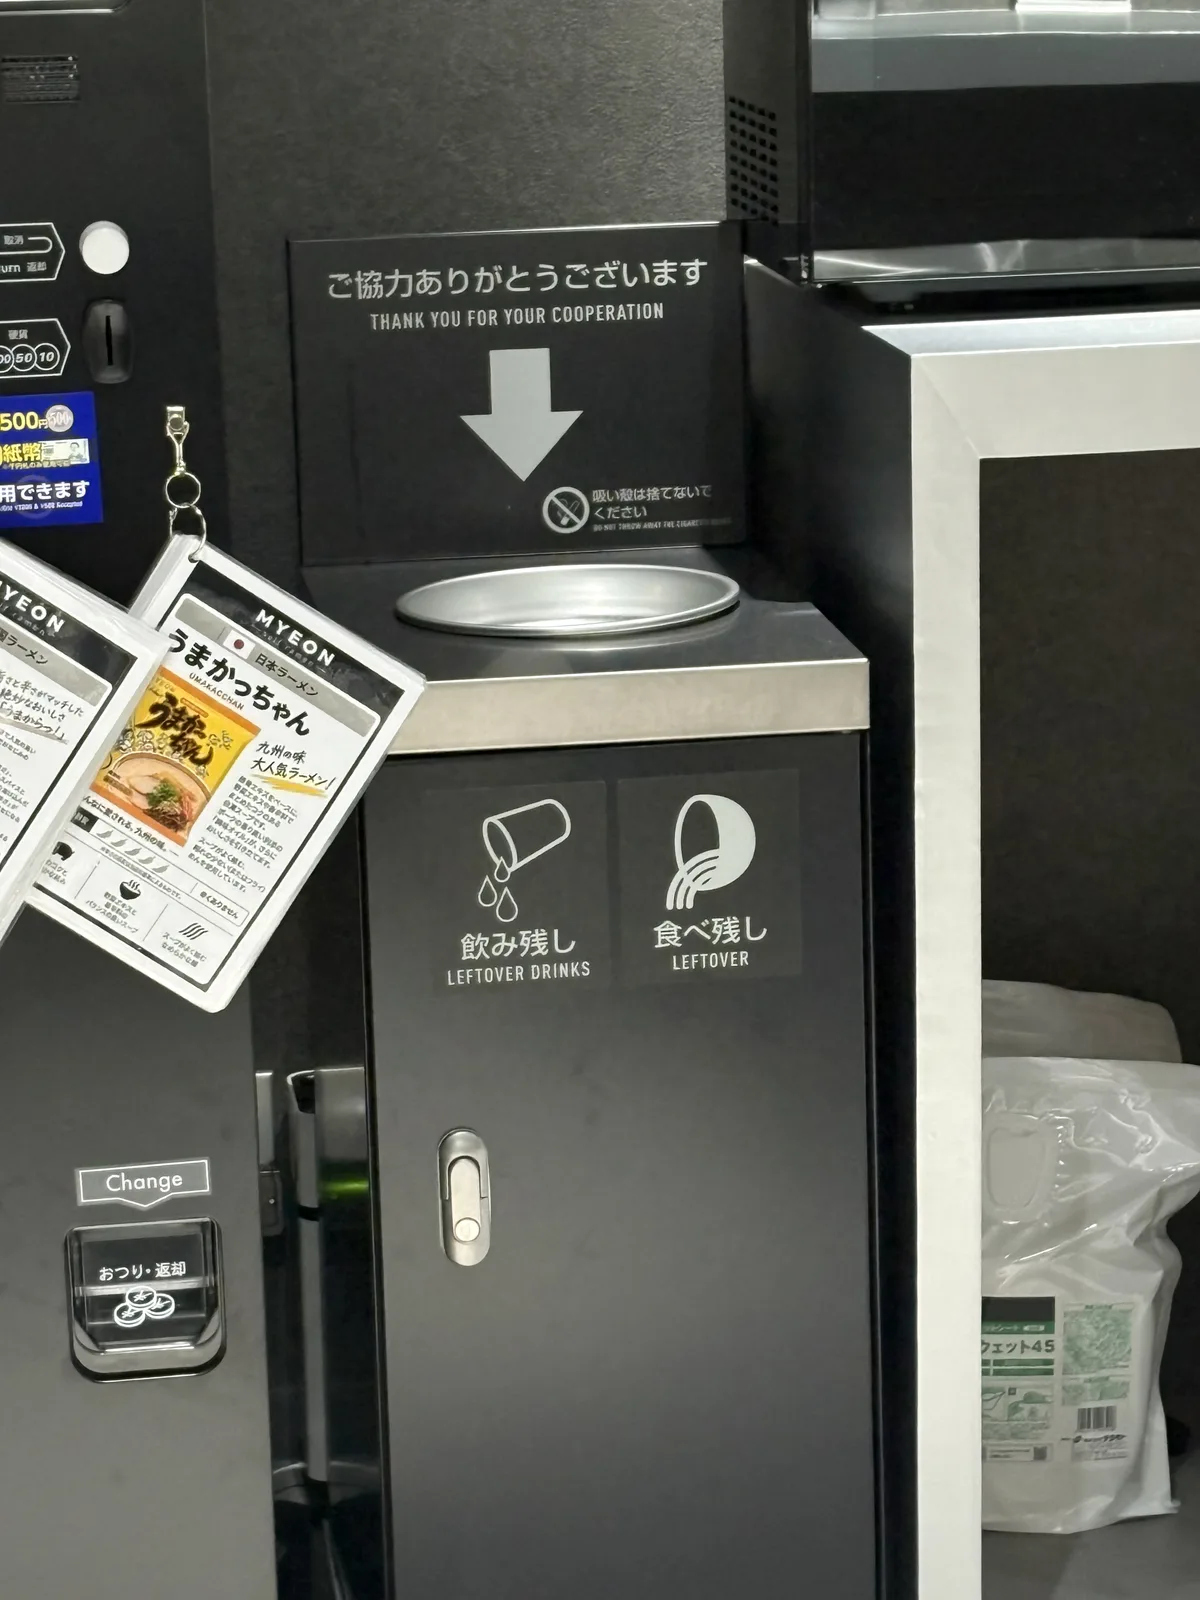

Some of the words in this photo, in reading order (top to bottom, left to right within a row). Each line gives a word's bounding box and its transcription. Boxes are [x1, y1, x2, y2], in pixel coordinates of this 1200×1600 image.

[328, 258, 708, 300] ご協力ありがとうございます
[370, 311, 425, 331] THANK
[430, 310, 461, 328] YOU
[467, 309, 498, 327] FOR
[503, 307, 546, 325] YOUR
[552, 302, 664, 323] COOPERATION
[16, 353, 32, 363] 50
[40, 352, 54, 362] 10
[0, 443, 41, 465] 紙幣
[592, 485, 712, 503] 吸い殻は捨てないで
[594, 505, 648, 520] ください
[0, 581, 65, 633] YEON
[255, 608, 335, 666] MYEON
[168, 628, 310, 737] うまかっちゃん
[254, 652, 318, 696] 日本ラーメン
[188, 672, 244, 710] UMAKACCHAN
[256, 741, 307, 764] 九州の味
[250, 756, 336, 791] 大人気ラーメン!
[460, 928, 576, 961] 飲み残し
[654, 916, 768, 949] 食べ残し
[447, 965, 524, 986] LEFTOVER
[531, 961, 590, 980] DRINKS
[672, 951, 749, 971] LEFTOVER
[105, 1172, 183, 1193] Change
[99, 1261, 187, 1281] おつり・返却
